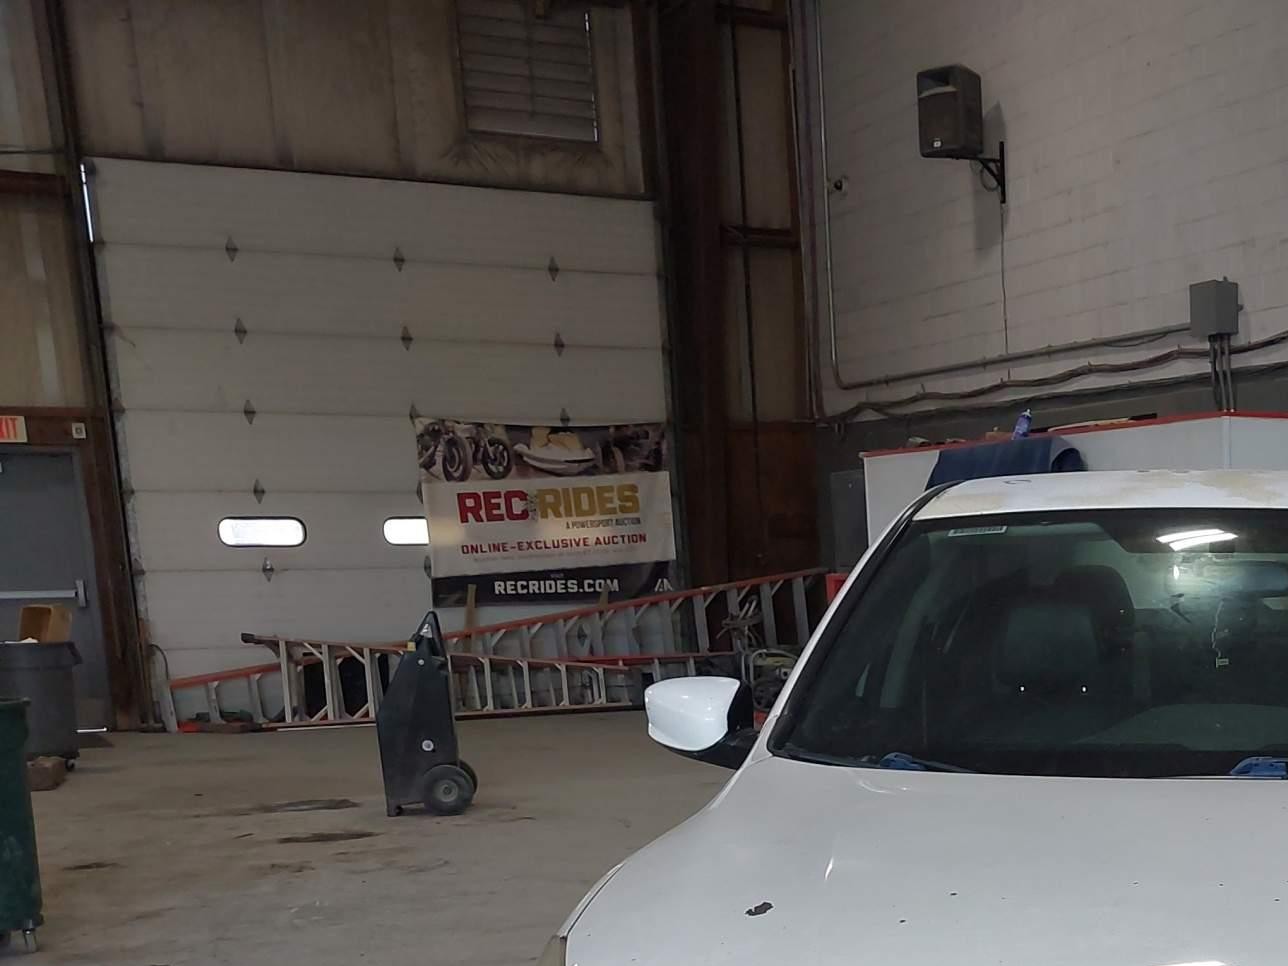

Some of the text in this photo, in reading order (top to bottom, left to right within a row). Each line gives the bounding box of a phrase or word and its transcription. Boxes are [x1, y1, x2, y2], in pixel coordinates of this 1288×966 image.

[457, 484, 640, 523] REC RIDES
[461, 537, 590, 554] ONLINE-EXCLUSIVE
[594, 533, 647, 546] AUCTION
[494, 579, 619, 595] RECRIDES.COM
